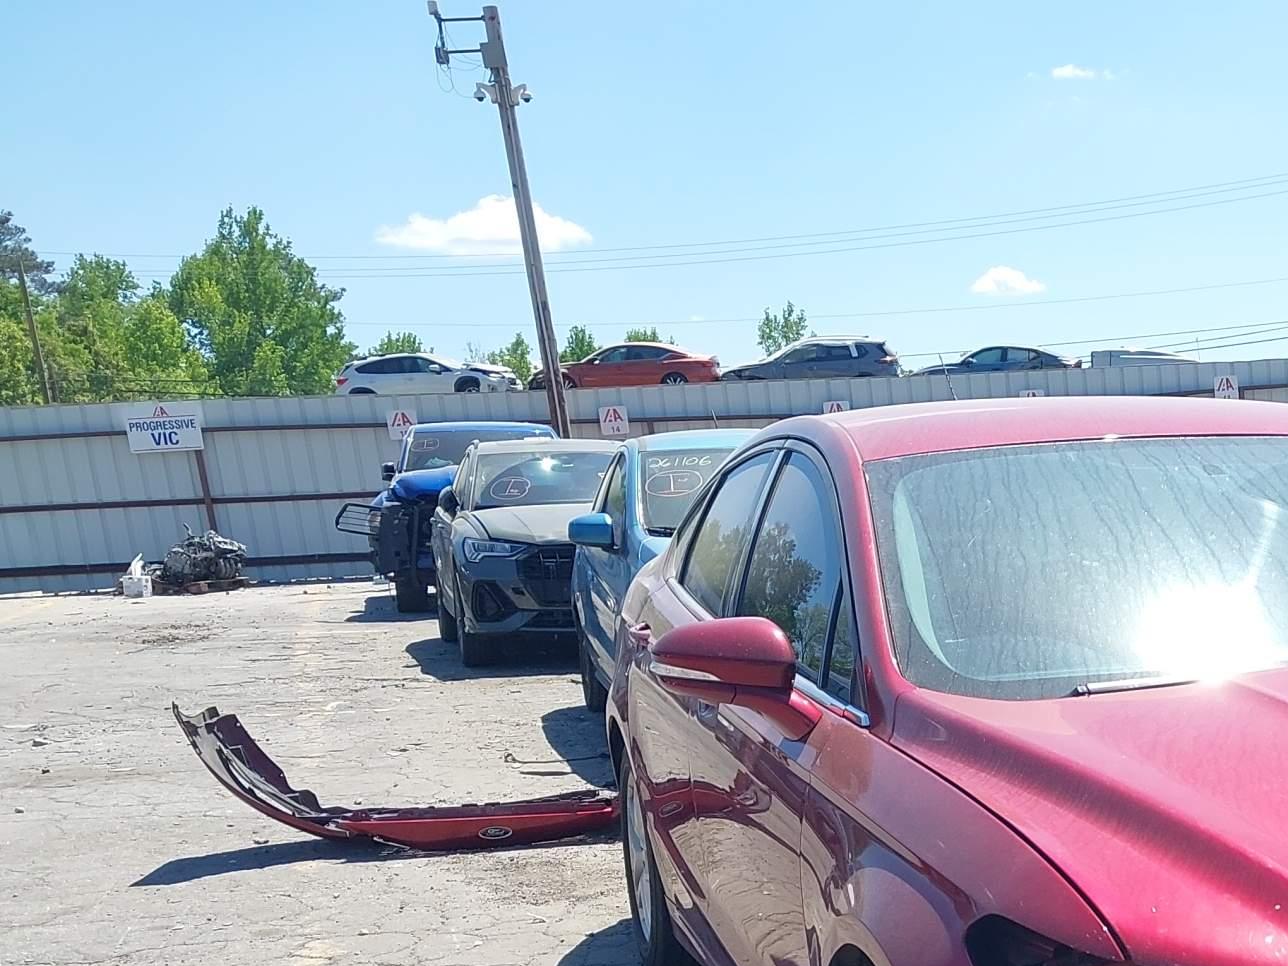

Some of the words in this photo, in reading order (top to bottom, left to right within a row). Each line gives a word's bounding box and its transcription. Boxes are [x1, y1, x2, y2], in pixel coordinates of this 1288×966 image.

[129, 419, 197, 432] PROGRESSIVE
[611, 425, 621, 433] 14
[151, 432, 180, 446] VIC
[648, 456, 712, 469] 261106
